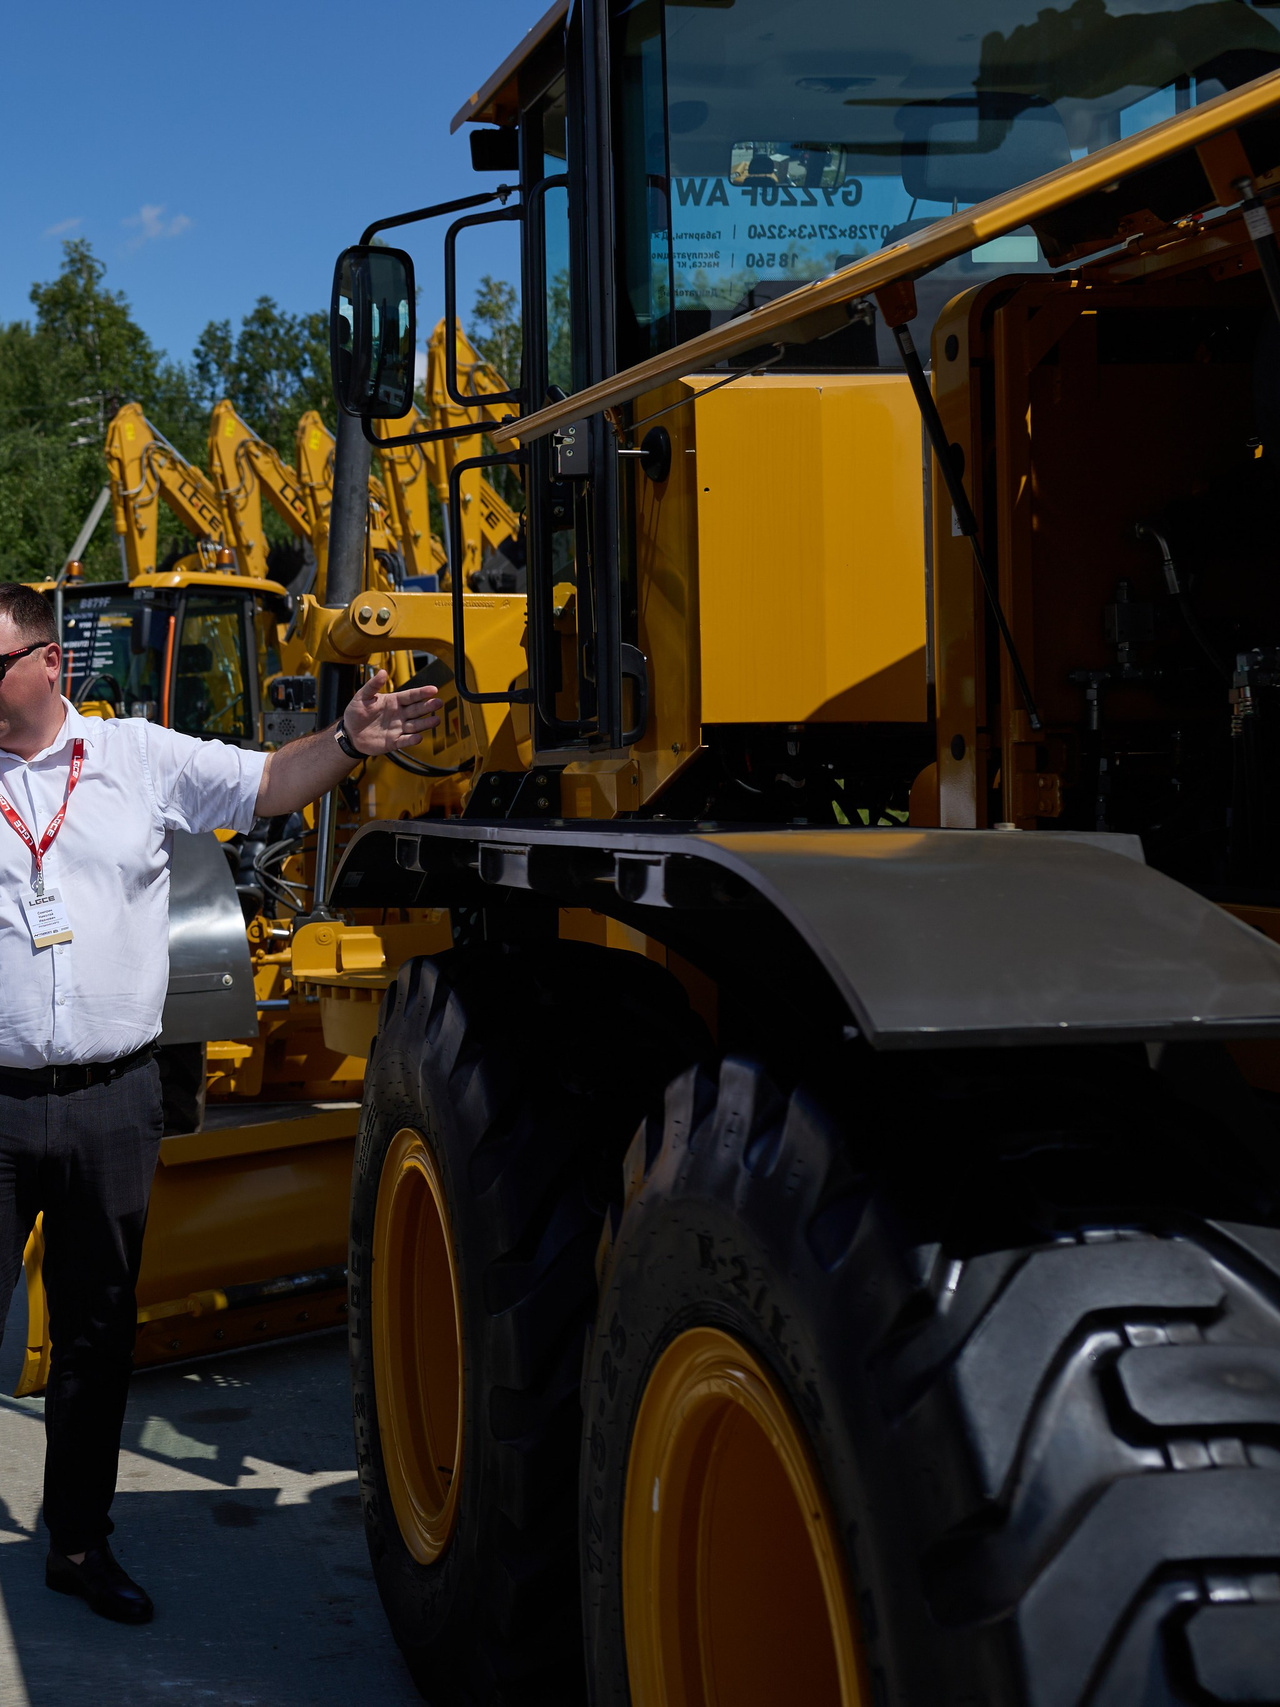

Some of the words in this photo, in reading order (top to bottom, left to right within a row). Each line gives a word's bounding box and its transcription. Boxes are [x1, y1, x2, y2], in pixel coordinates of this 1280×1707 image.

[178, 481, 222, 532] LGCE
[72, 755, 81, 779] LGCE
[14, 819, 34, 846] LGCE
[47, 813, 64, 837] LGCE
[29, 895, 56, 907] LGCE
